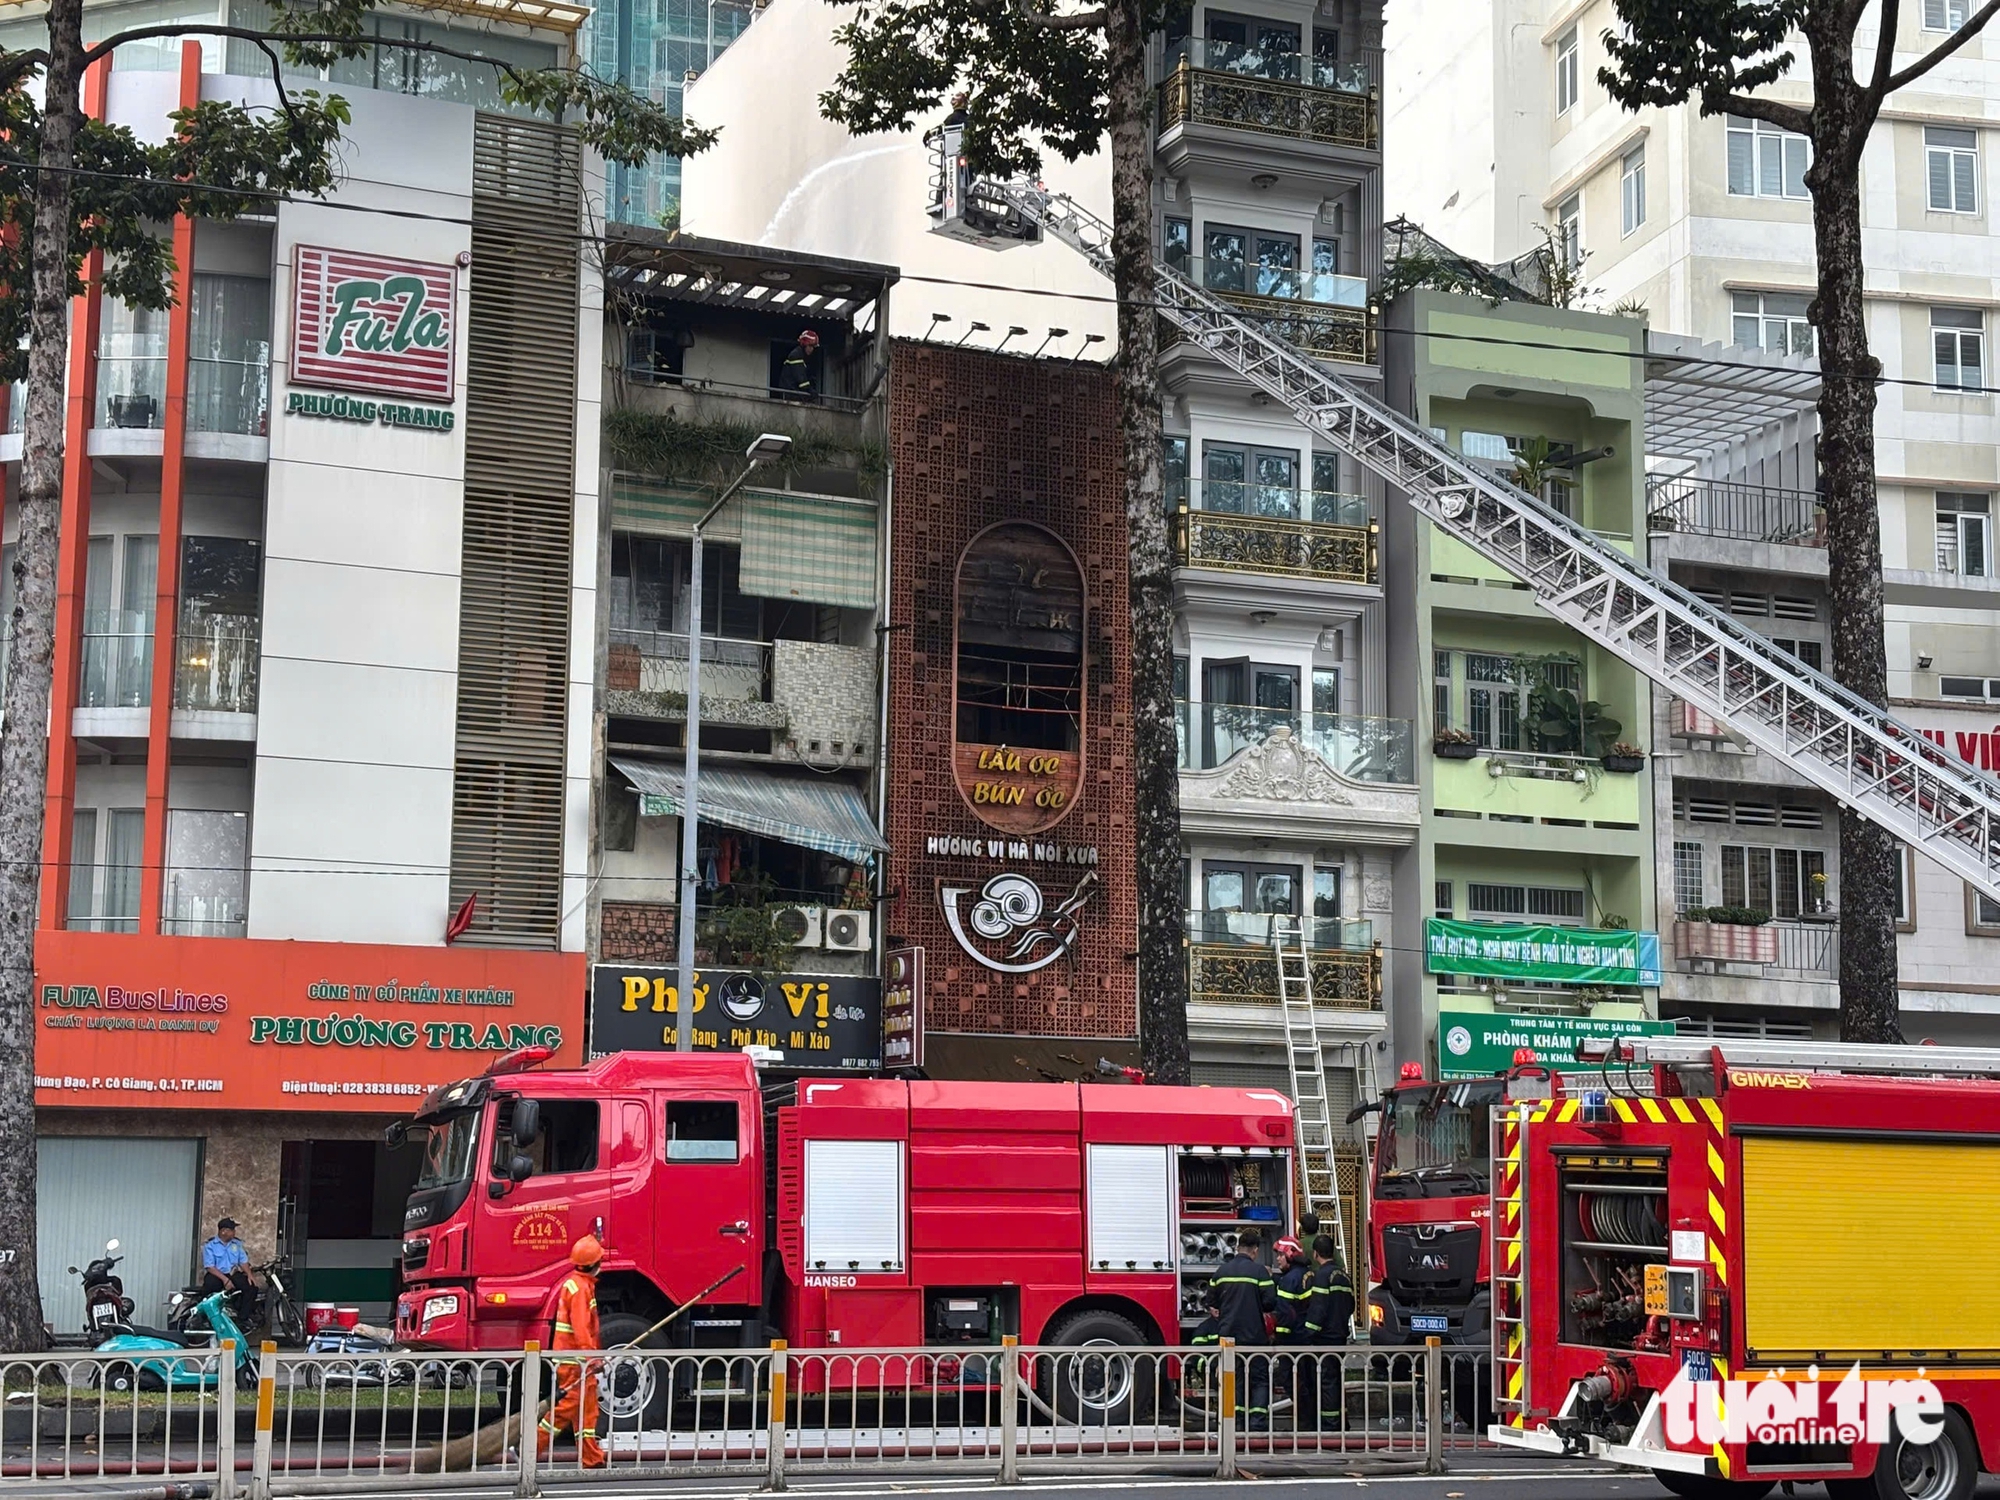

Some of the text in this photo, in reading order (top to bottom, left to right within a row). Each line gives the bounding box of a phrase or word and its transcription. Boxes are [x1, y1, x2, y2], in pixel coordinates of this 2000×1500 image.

[288, 393, 456, 431] PHƯƠNG TRANG
[927, 834, 982, 857] HƯƠNG
[988, 840, 1004, 863] VỊ
[1008, 837, 1029, 861] HÀ
[42, 985, 102, 1008] FUTA
[307, 979, 350, 1000] CÔNG
[353, 985, 372, 1000] TY
[400, 981, 439, 1003] PHẦN
[443, 988, 462, 1004] XE
[465, 985, 514, 1006] KHÁCH
[781, 982, 829, 1028] Vị
[87, 1016, 135, 1032] LƯỢNG
[138, 1017, 156, 1031] LÀ
[159, 1019, 197, 1034] DANH
[250, 1012, 563, 1050] PHƯƠNG TRANG
[1510, 1018, 1536, 1029] TRUNG
[1538, 1018, 1555, 1029] TÂM
[1557, 1021, 1562, 1030] Y
[1564, 1020, 1574, 1030] TẾ
[1576, 1022, 1591, 1031] KHU
[1611, 1021, 1624, 1032] SÀI
[1626, 1023, 1642, 1033] GÒN
[810, 1032, 830, 1050] Xào
[1484, 1029, 1529, 1047] PHÒNG
[1533, 1032, 1572, 1049] KHÁM
[64, 1076, 89, 1092] Đạo,
[92, 1077, 103, 1089] P.
[105, 1077, 120, 1089] Cô
[122, 1077, 157, 1091] Giang,
[282, 1081, 307, 1095] Điện
[343, 1082, 363, 1093] 028
[365, 1083, 392, 1094] 3838
[1731, 1071, 1812, 1090] GIMAEX
[528, 1223, 553, 1237] 114
[804, 1276, 857, 1287] HANSEO
